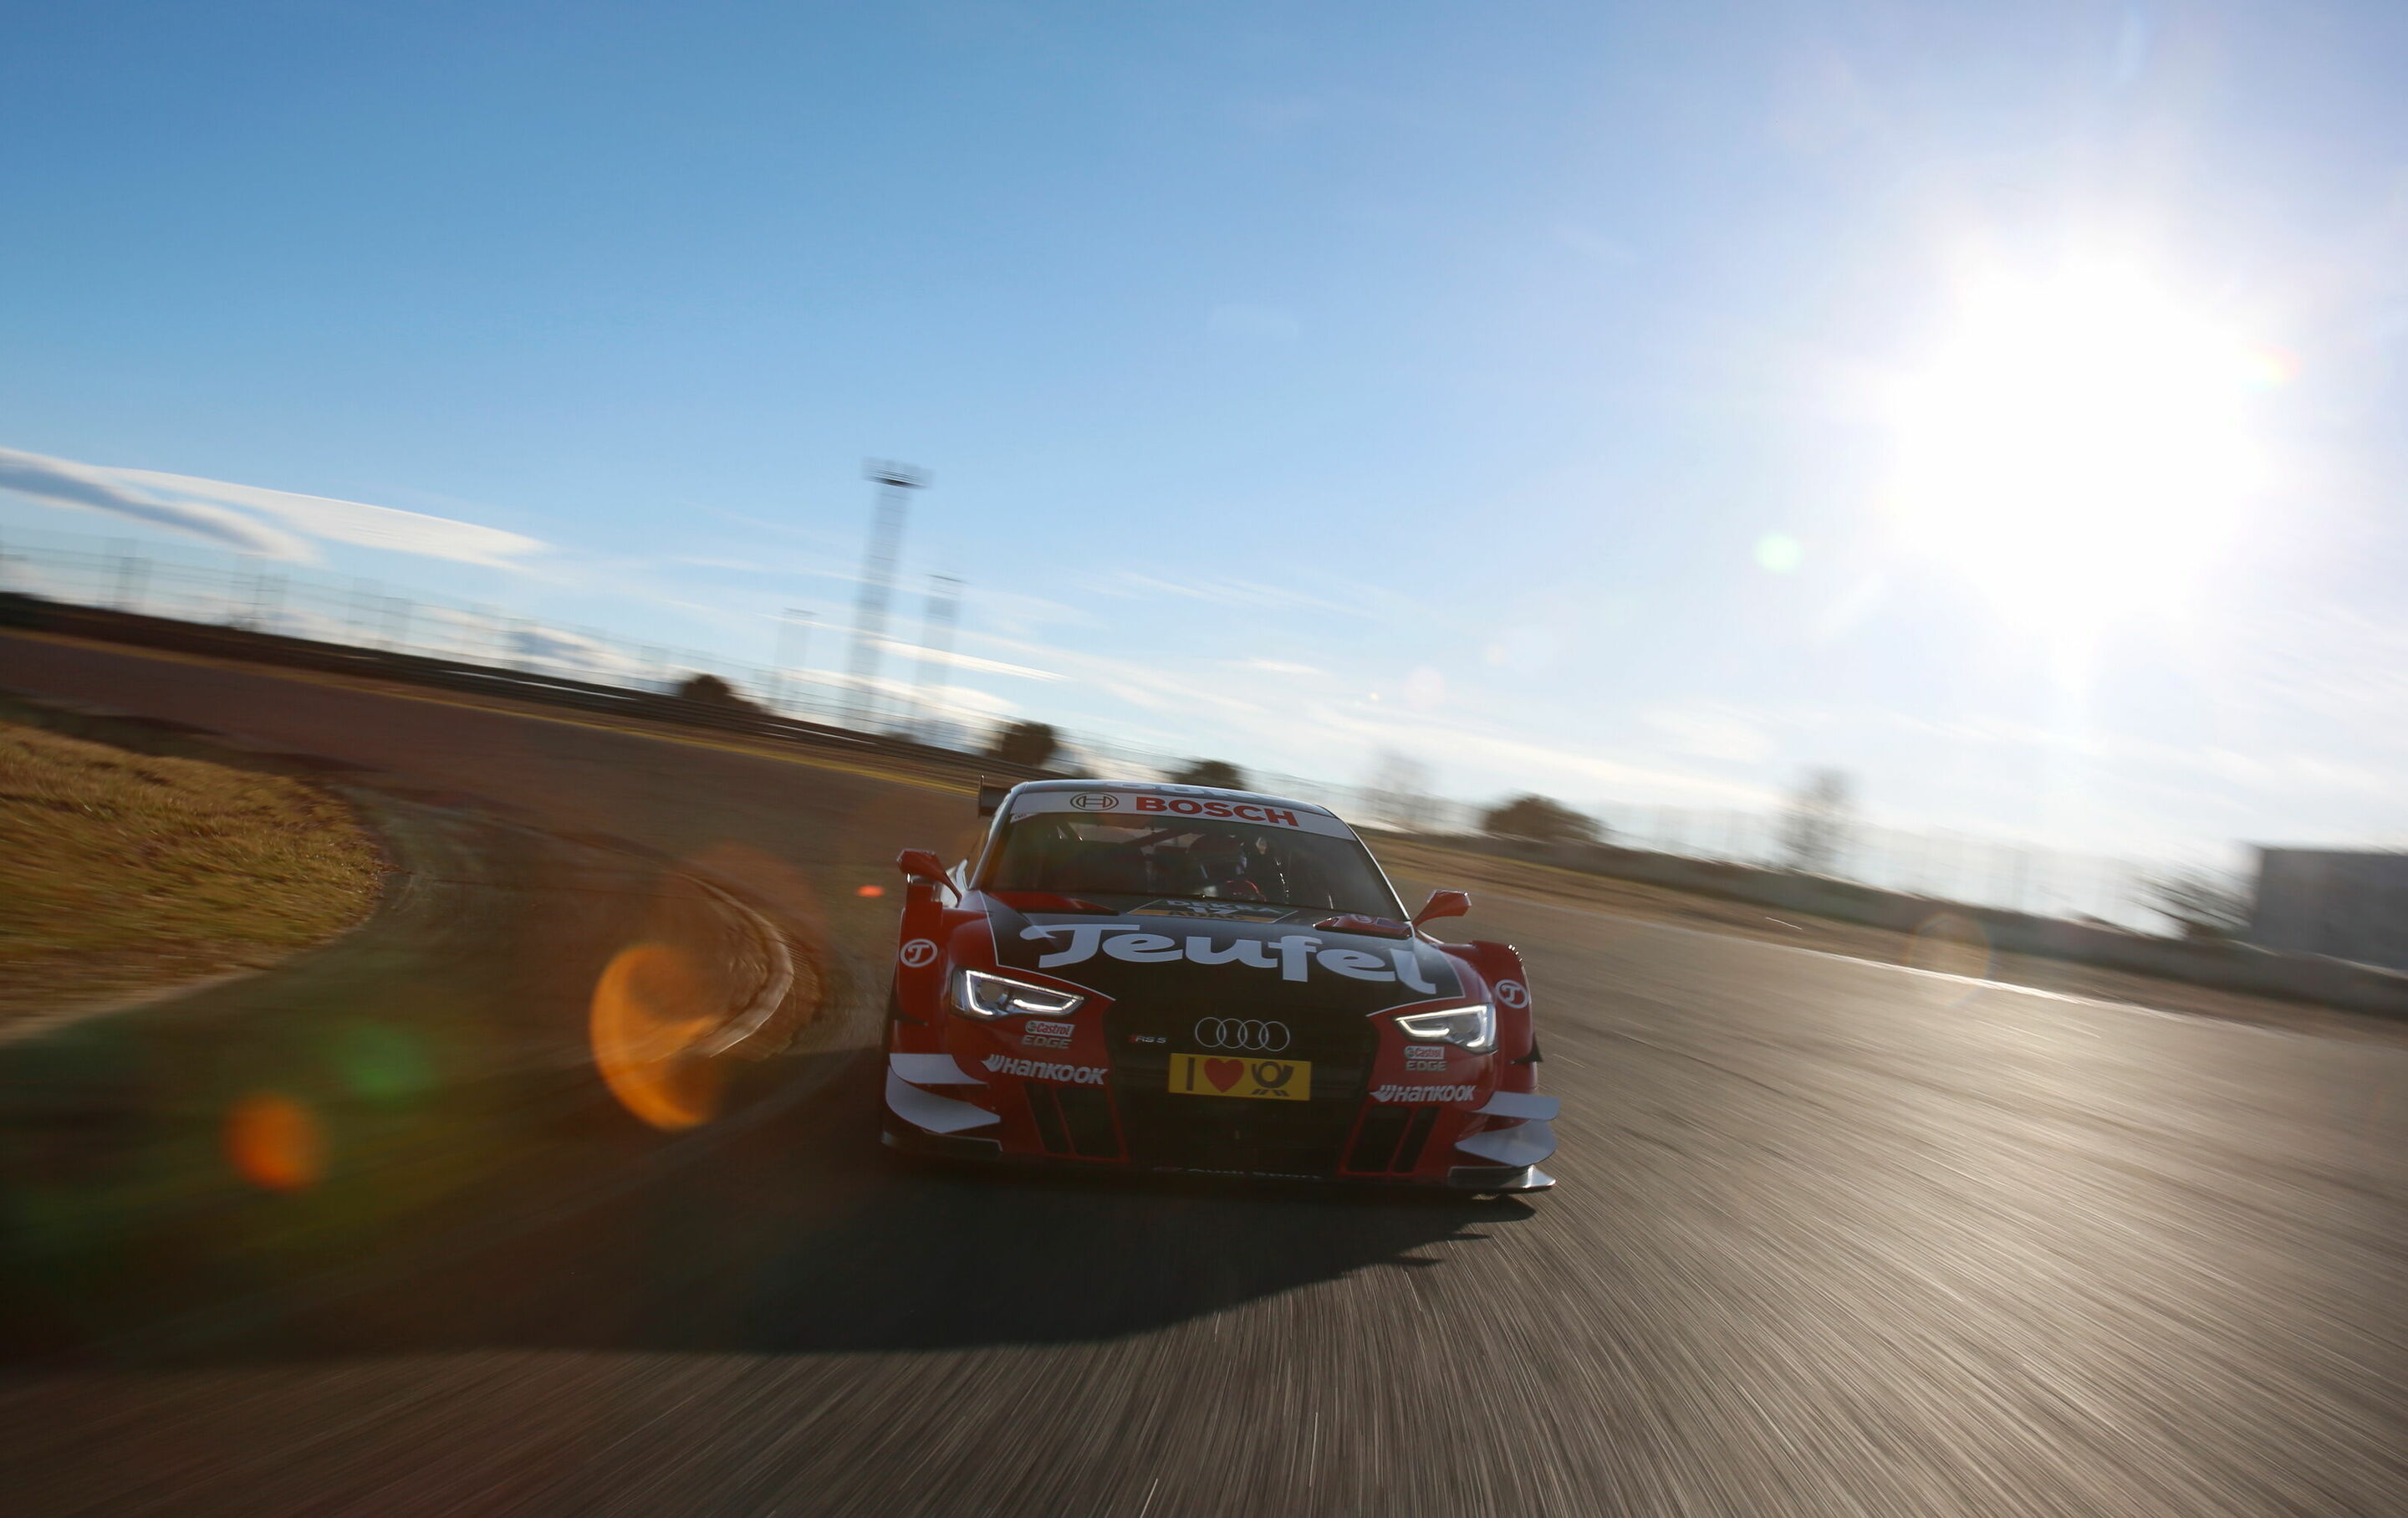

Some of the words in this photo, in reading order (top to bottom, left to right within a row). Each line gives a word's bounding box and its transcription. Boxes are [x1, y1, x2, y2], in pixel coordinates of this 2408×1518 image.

[1135, 796, 1299, 827] BOSCH
[1019, 923, 1436, 994] Teufel
[1036, 1022, 1071, 1035] Castrol
[1021, 1035, 1073, 1049] EDGE
[1406, 1061, 1446, 1071] EDGE
